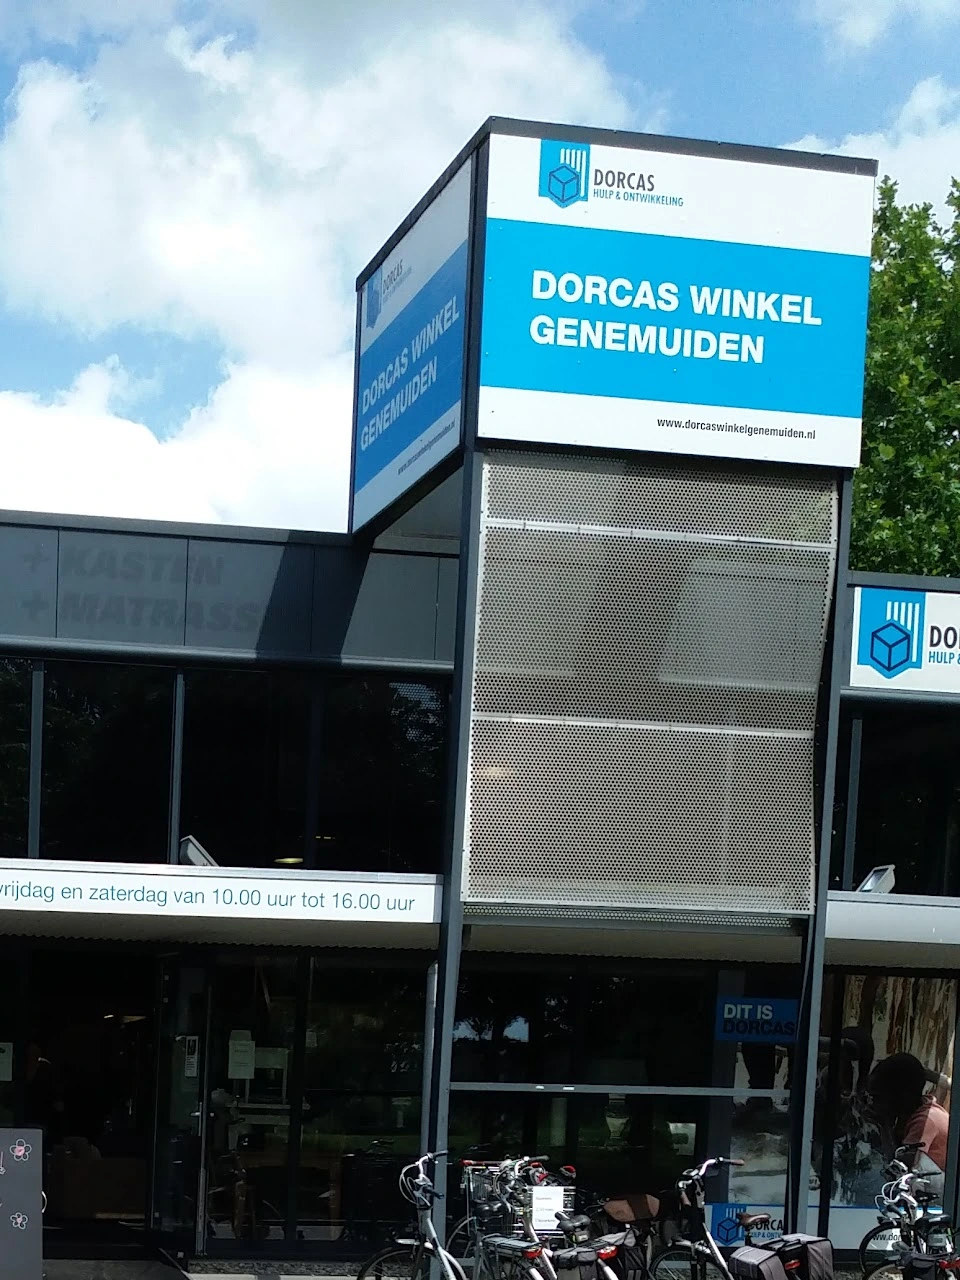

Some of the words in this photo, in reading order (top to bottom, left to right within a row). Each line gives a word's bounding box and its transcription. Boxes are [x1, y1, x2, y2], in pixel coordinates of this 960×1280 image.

[594, 169, 655, 192] DORCAS
[593, 188, 614, 200] HULP
[615, 191, 621, 200] &
[623, 191, 684, 207] ONTWIKKELING
[532, 270, 679, 312] DORCAS
[689, 285, 822, 326] WINKEL
[530, 315, 765, 364] GENEMUIDEN
[362, 346, 409, 415] DORCAS
[411, 296, 460, 363] WINKEL
[361, 356, 438, 452] GENEMUIDEN
[657, 417, 816, 440] www.dorcaswinkelgenemuiden.nl
[60, 545, 224, 586] KASTEN
[929, 625, 960, 650] DO
[928, 651, 955, 664] HULP
[61, 886, 83, 900] en
[89, 885, 168, 907] zaterdag
[173, 890, 205, 904] van
[213, 889, 261, 906] 10.00
[267, 894, 297, 908] uur
[301, 891, 325, 908] tot
[332, 892, 380, 910] 16.00
[386, 896, 415, 911] uur
[723, 1003, 753, 1019] DIT
[757, 1005, 773, 1020] IS
[723, 1020, 796, 1036] DORCAS
